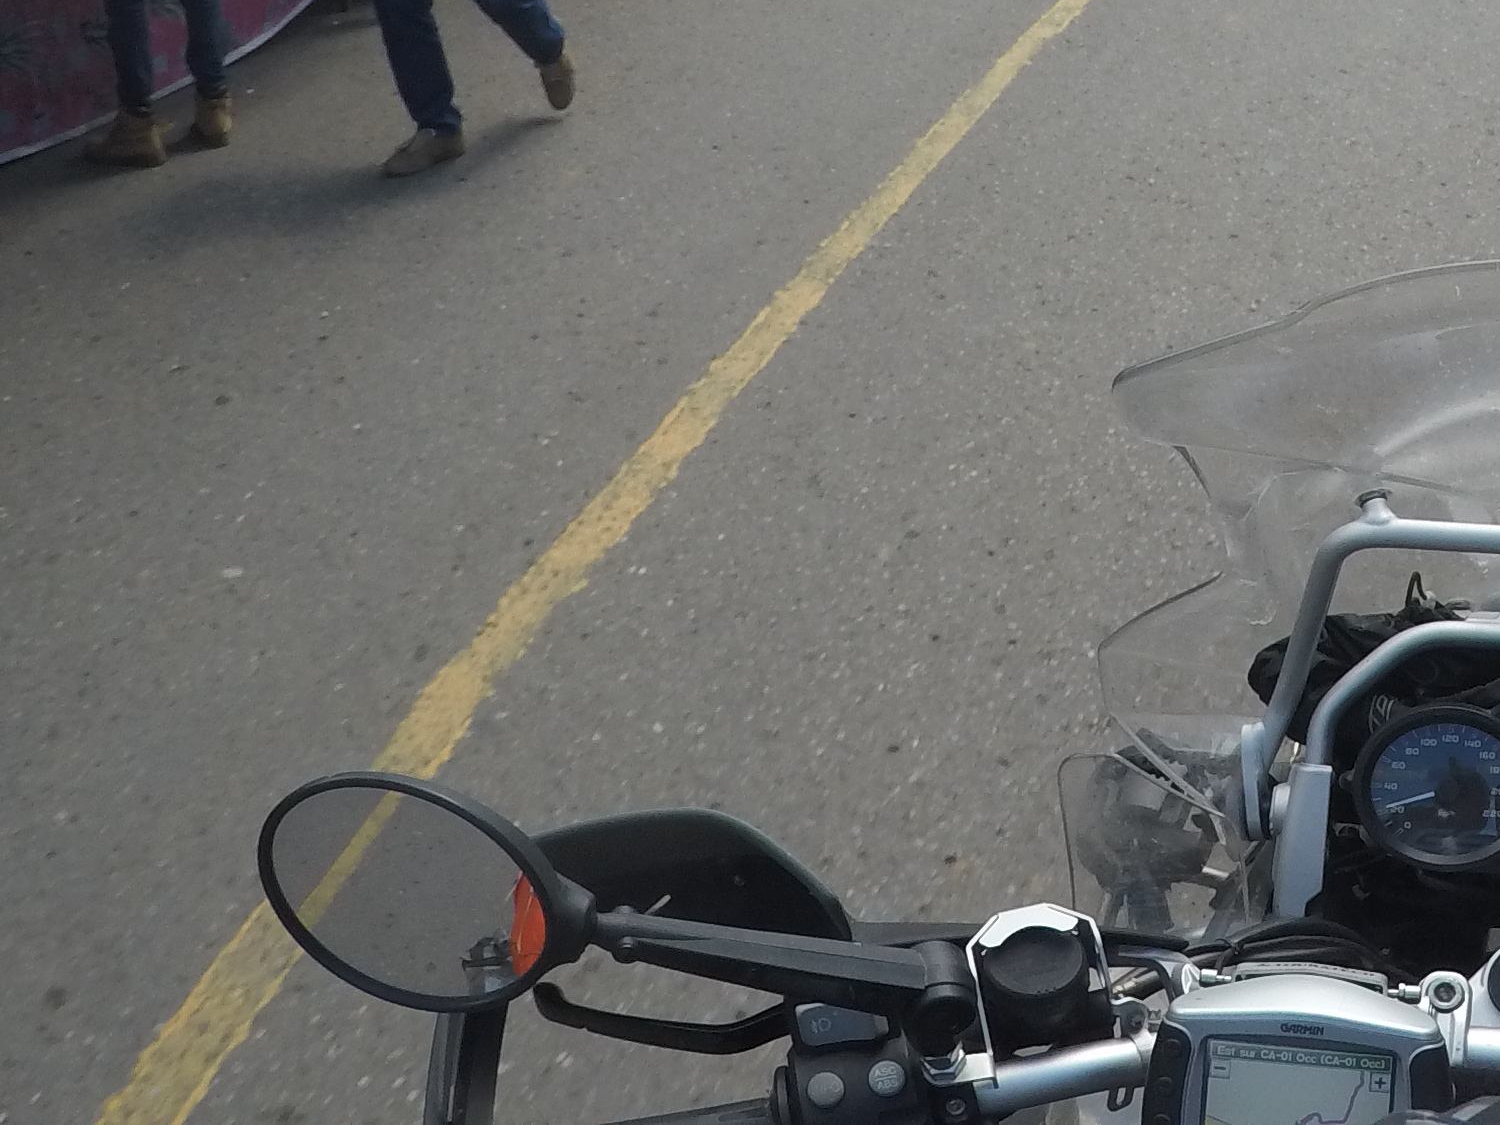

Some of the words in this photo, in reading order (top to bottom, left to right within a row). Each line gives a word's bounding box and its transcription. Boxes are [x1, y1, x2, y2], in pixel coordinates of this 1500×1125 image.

[1384, 782, 1398, 791] 40
[1280, 1023, 1325, 1036] GARMIN
[1217, 1045, 1236, 1057] Est
[1240, 1048, 1256, 1058] sur
[1260, 1050, 1293, 1062] CA-01
[1320, 1055, 1357, 1067] (CA-01
[874, 1066, 898, 1077] ASC
[877, 1079, 899, 1090] ABS
